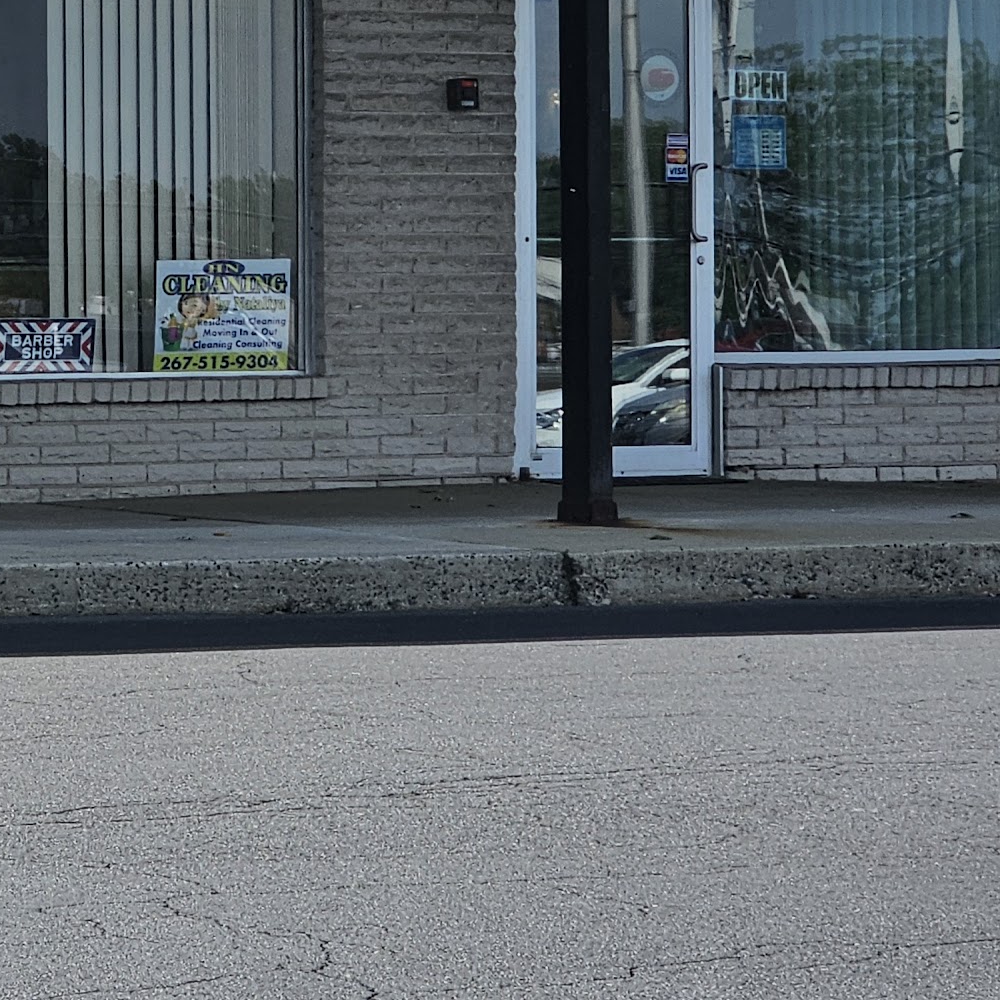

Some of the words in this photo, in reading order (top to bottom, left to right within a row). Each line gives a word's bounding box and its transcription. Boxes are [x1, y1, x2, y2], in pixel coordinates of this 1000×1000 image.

[734, 71, 786, 100] OPEN
[669, 167, 687, 175] VISA
[162, 273, 288, 296] CLEANING
[198, 316, 245, 326] Residential
[249, 316, 287, 327] Cleaning
[202, 328, 237, 338] Moving
[240, 328, 249, 336] In
[261, 328, 278, 336] Out
[11, 334, 74, 347] BARBER
[192, 339, 233, 350] Cleaning
[21, 346, 64, 360] SHOP
[160, 354, 279, 371] 267-515-9304
